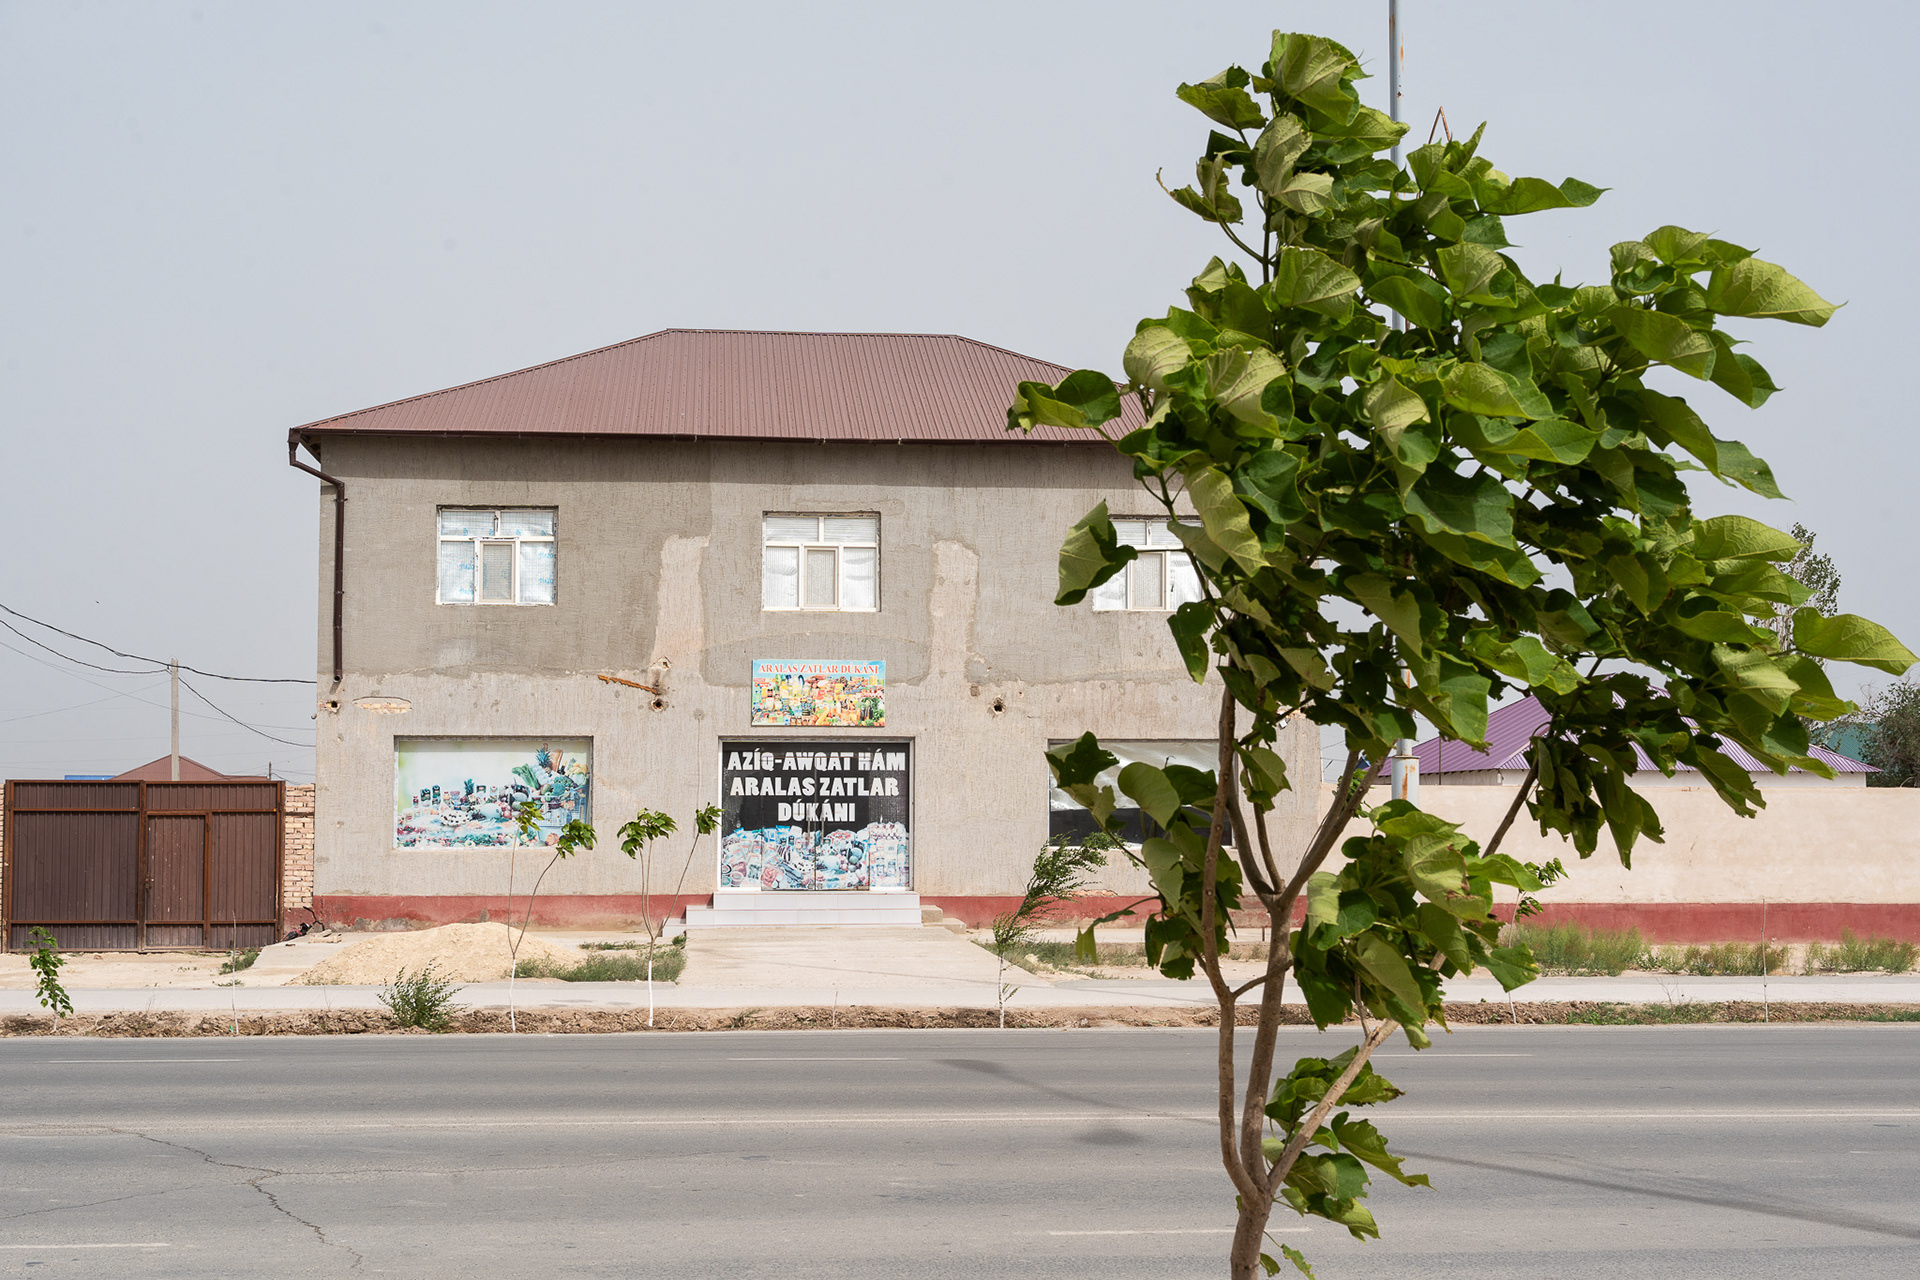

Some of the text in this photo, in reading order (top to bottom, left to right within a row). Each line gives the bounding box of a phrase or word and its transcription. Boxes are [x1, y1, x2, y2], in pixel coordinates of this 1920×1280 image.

[758, 664, 798, 674] ARALAS
[799, 664, 839, 674] ZATLAR
[727, 747, 906, 772] AZÍQ-AWQAT HÁM
[730, 777, 900, 797] ARALAS ZATLAR
[777, 798, 856, 822] DÚKÁNI
